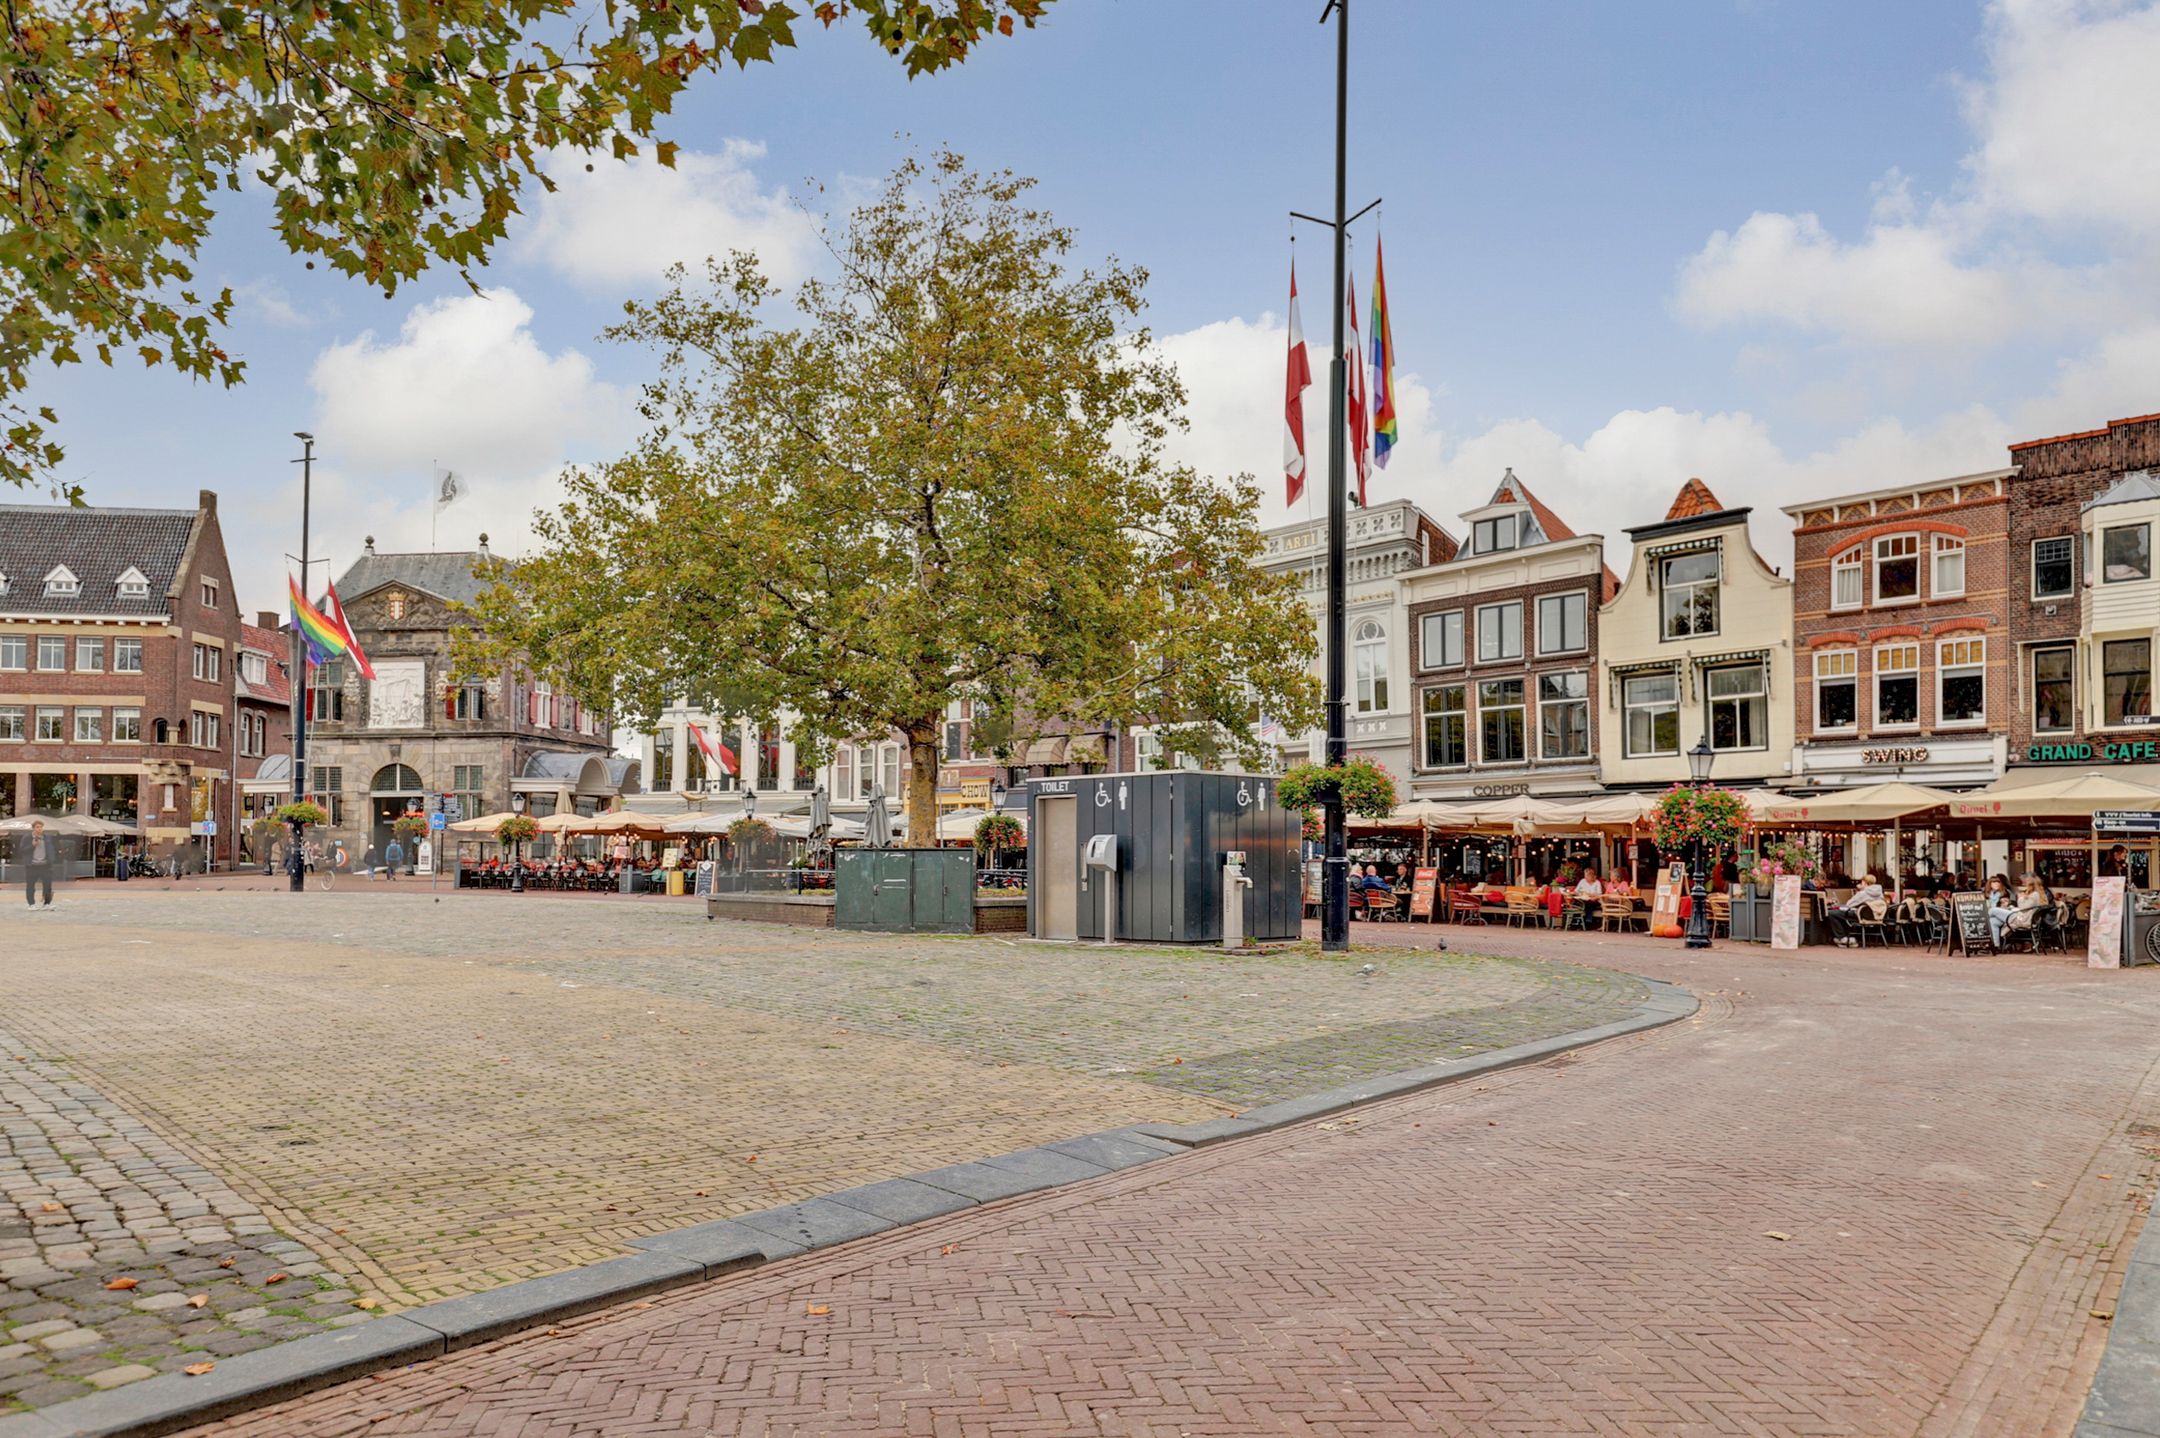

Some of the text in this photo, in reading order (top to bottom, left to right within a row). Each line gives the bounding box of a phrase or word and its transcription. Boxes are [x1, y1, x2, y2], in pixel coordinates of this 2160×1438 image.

[1285, 533, 1317, 550] ARTI
[1861, 746, 1929, 764] SWING
[2027, 741, 2156, 761] GRAND CAFE
[961, 783, 989, 798] CHOW
[1041, 781, 1070, 792] TOILET
[1473, 783, 1530, 797] COPPER
